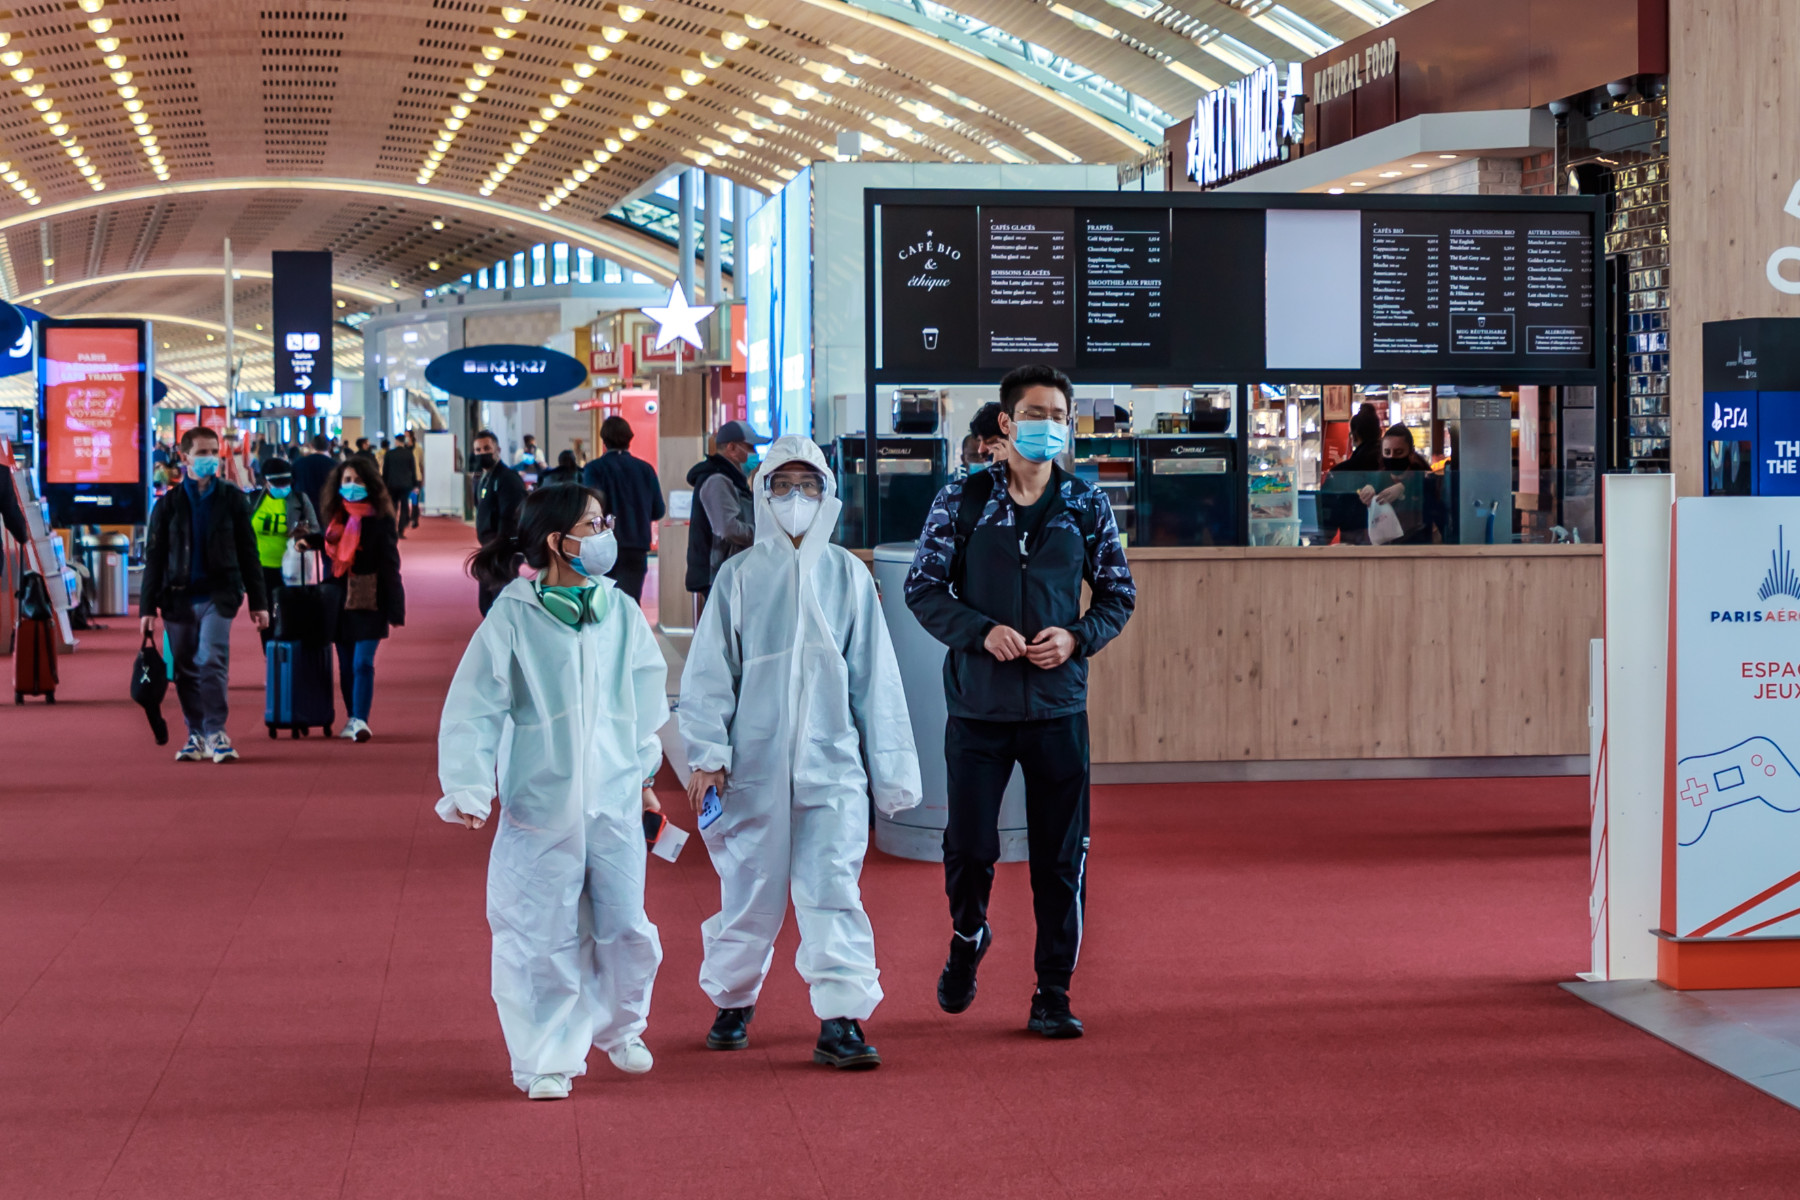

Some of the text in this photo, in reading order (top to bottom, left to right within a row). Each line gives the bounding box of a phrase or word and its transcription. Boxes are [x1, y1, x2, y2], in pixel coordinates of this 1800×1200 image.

[1313, 36, 1396, 106] NATURAL FOOD
[898, 240, 961, 260] CAFÉ BIO
[924, 258, 938, 270] &
[1022, 268, 1050, 276] GLACÉES
[907, 273, 951, 292] éthique
[593, 352, 620, 371] RELA
[87, 372, 126, 382] TRAVEL
[1723, 407, 1748, 428] PS4
[1766, 459, 1797, 474] THE
[1764, 607, 1800, 622] AÉR
[1741, 661, 1800, 678] ESPA
